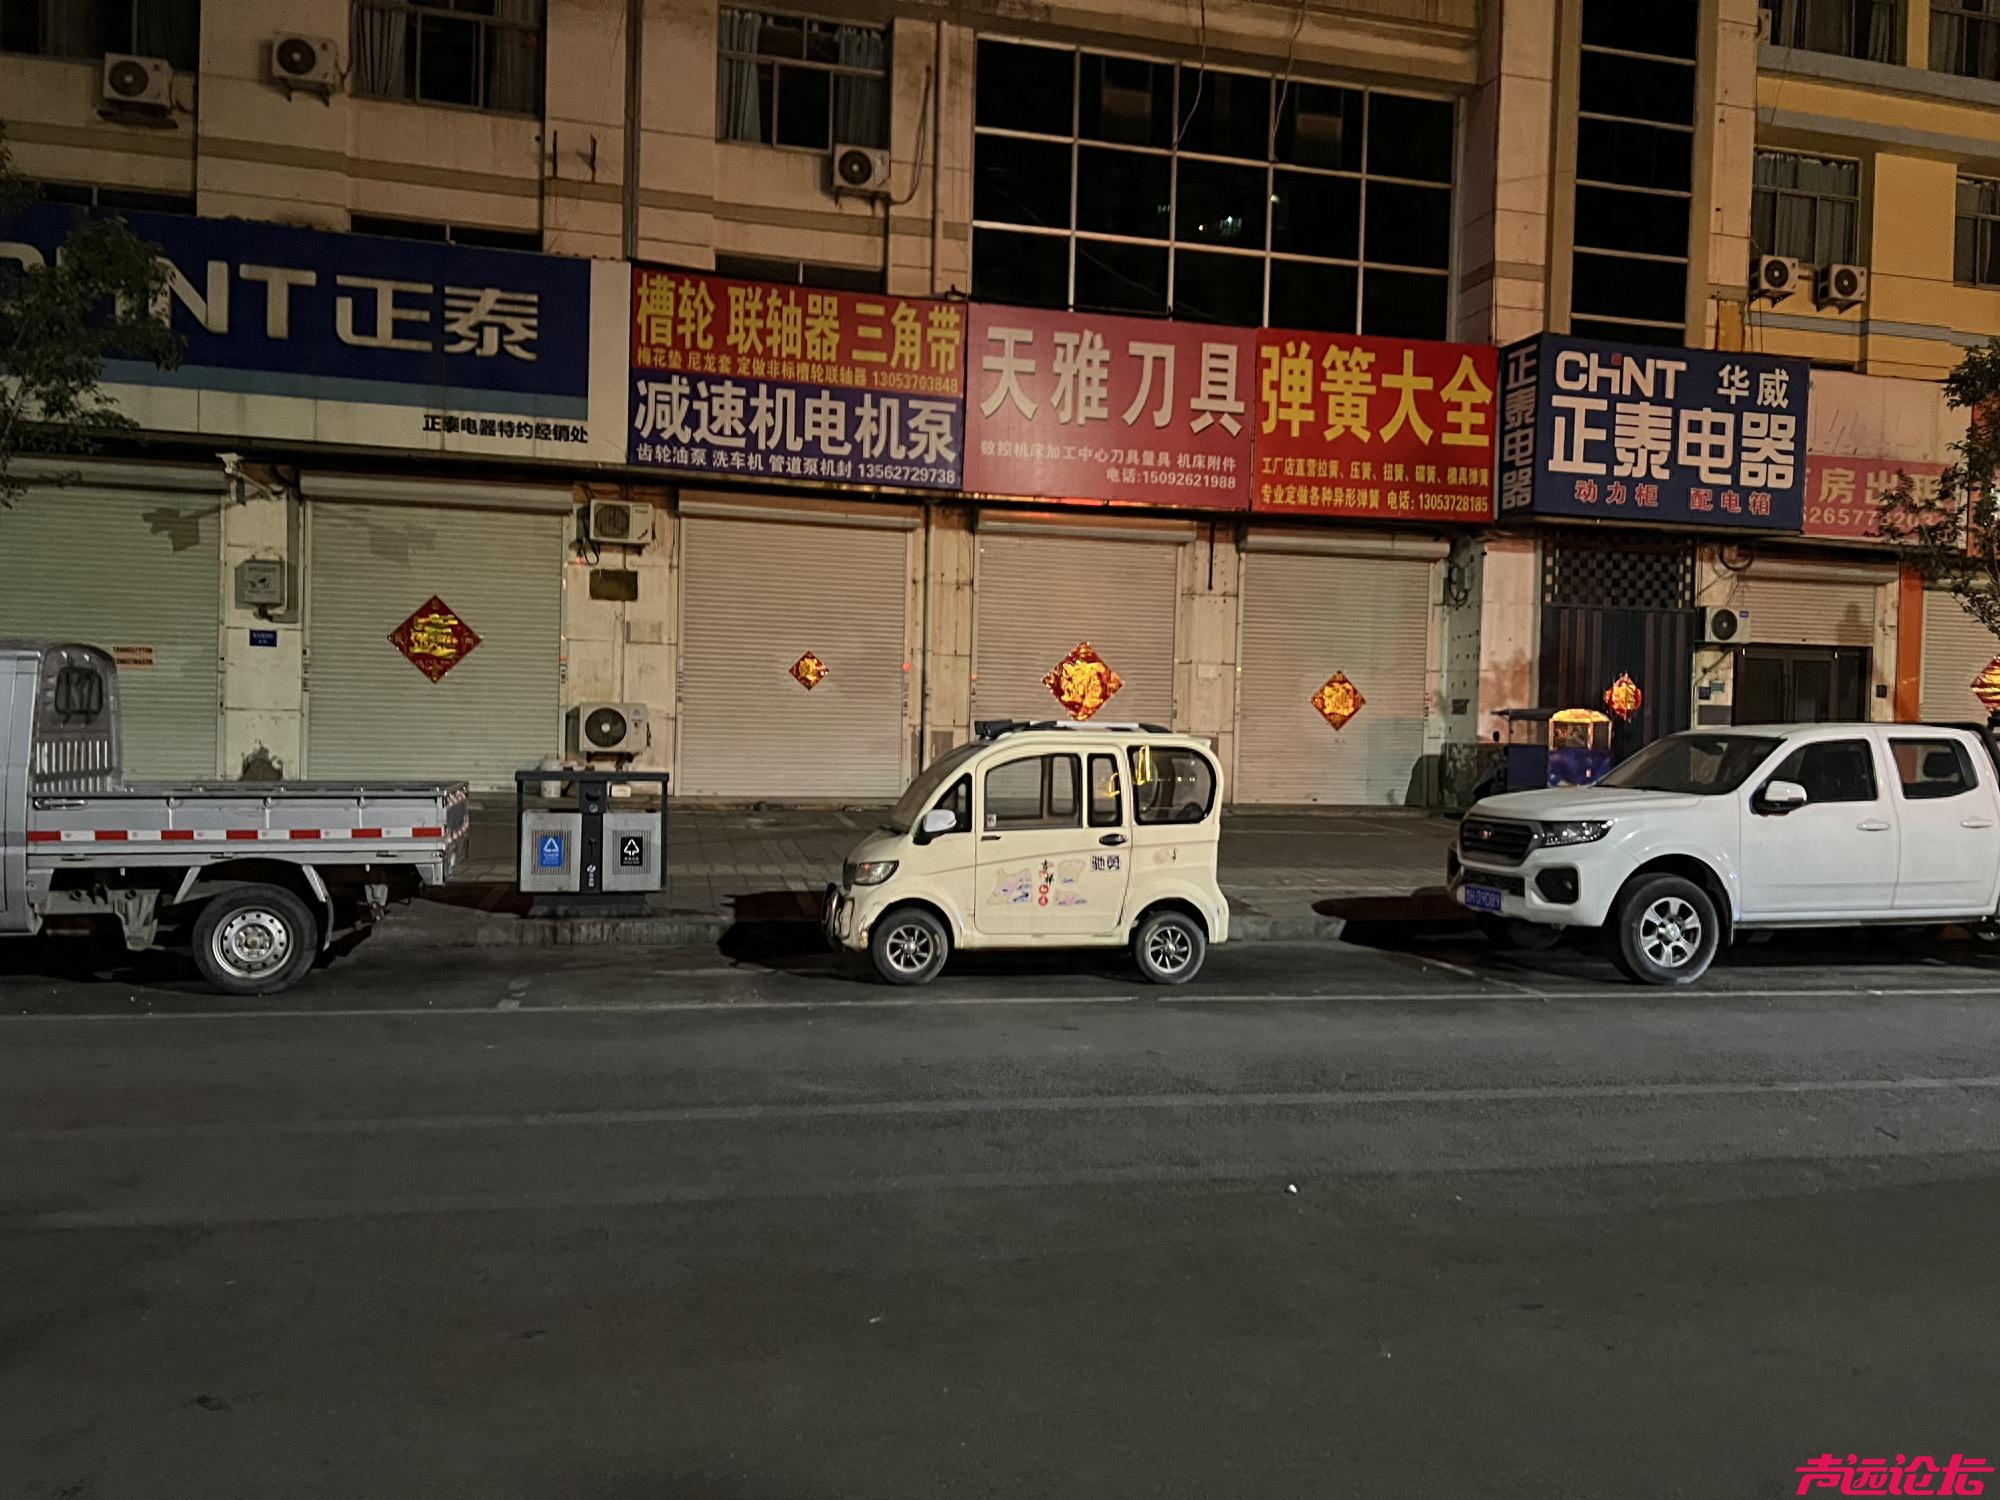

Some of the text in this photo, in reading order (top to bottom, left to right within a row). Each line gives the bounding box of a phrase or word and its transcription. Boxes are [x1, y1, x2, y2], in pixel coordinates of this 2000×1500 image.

[335, 274, 540, 362] 正泰
[637, 273, 961, 374] 槽轮 联轴器 三角带
[688, 351, 732, 375] 尼龙套
[979, 326, 1246, 437] 天雅刀具
[1260, 341, 1494, 447] 弹簧大全
[1717, 364, 1790, 409] 华威
[422, 414, 589, 444] 正泰电器特约经销处
[634, 375, 958, 465] 减速机电机泵
[636, 442, 956, 485] 齿轮油泵 洗车机 管道泵机封 13562729738
[1176, 452, 1237, 472] 机床附件
[1501, 343, 1539, 511] 正泰电器
[1548, 394, 1796, 490] 正泰电器
[1574, 478, 1772, 516] 动力柜 配电箱
